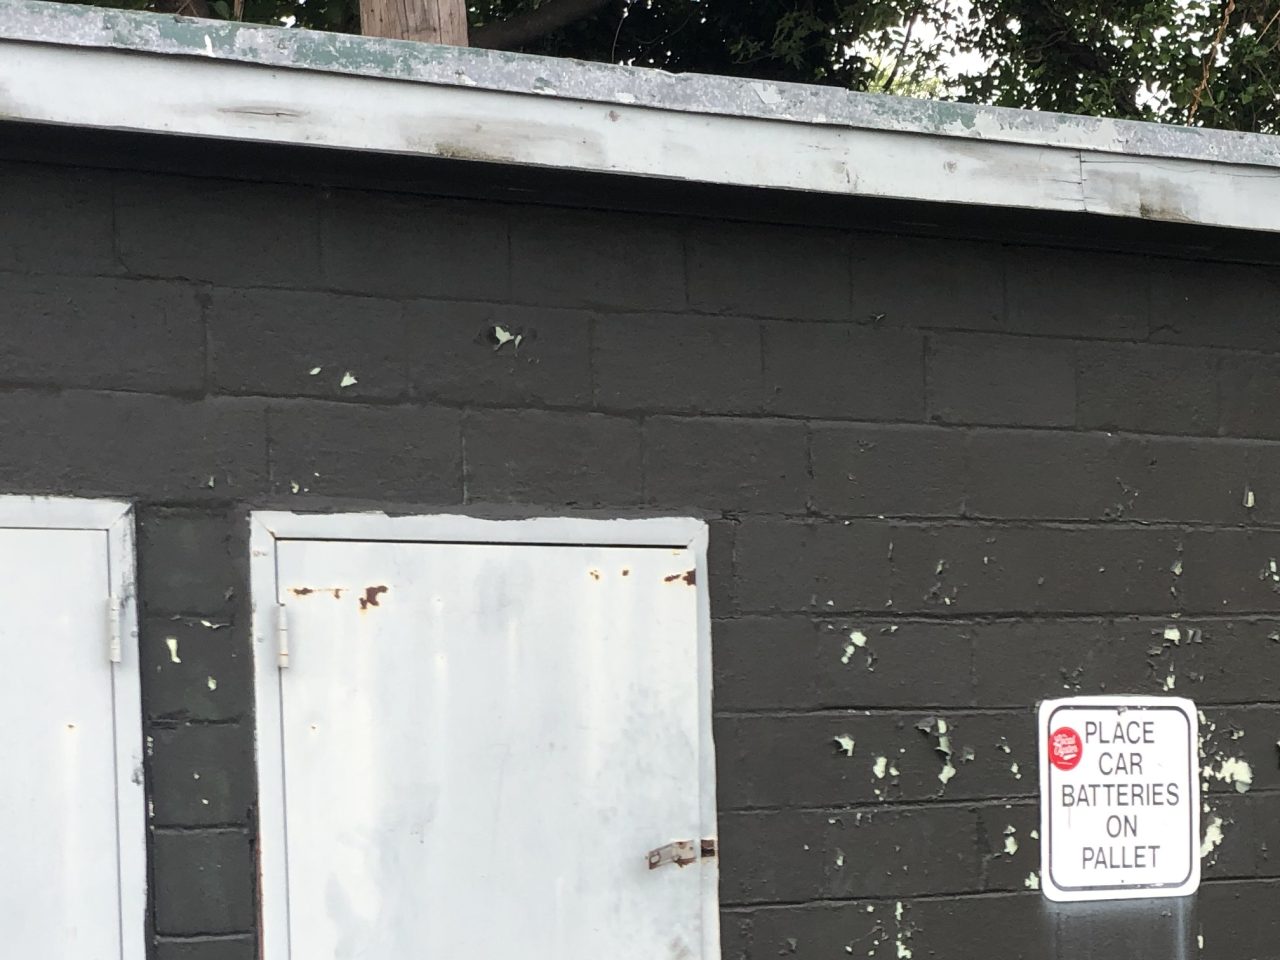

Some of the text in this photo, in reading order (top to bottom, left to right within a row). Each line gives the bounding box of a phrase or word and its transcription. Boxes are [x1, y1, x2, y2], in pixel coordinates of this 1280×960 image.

[1085, 721, 1155, 744] PLACE
[1098, 752, 1143, 775] CAR
[1062, 782, 1180, 807] BATTERIES
[1106, 814, 1137, 838] ON
[1082, 845, 1160, 869] PALLET
